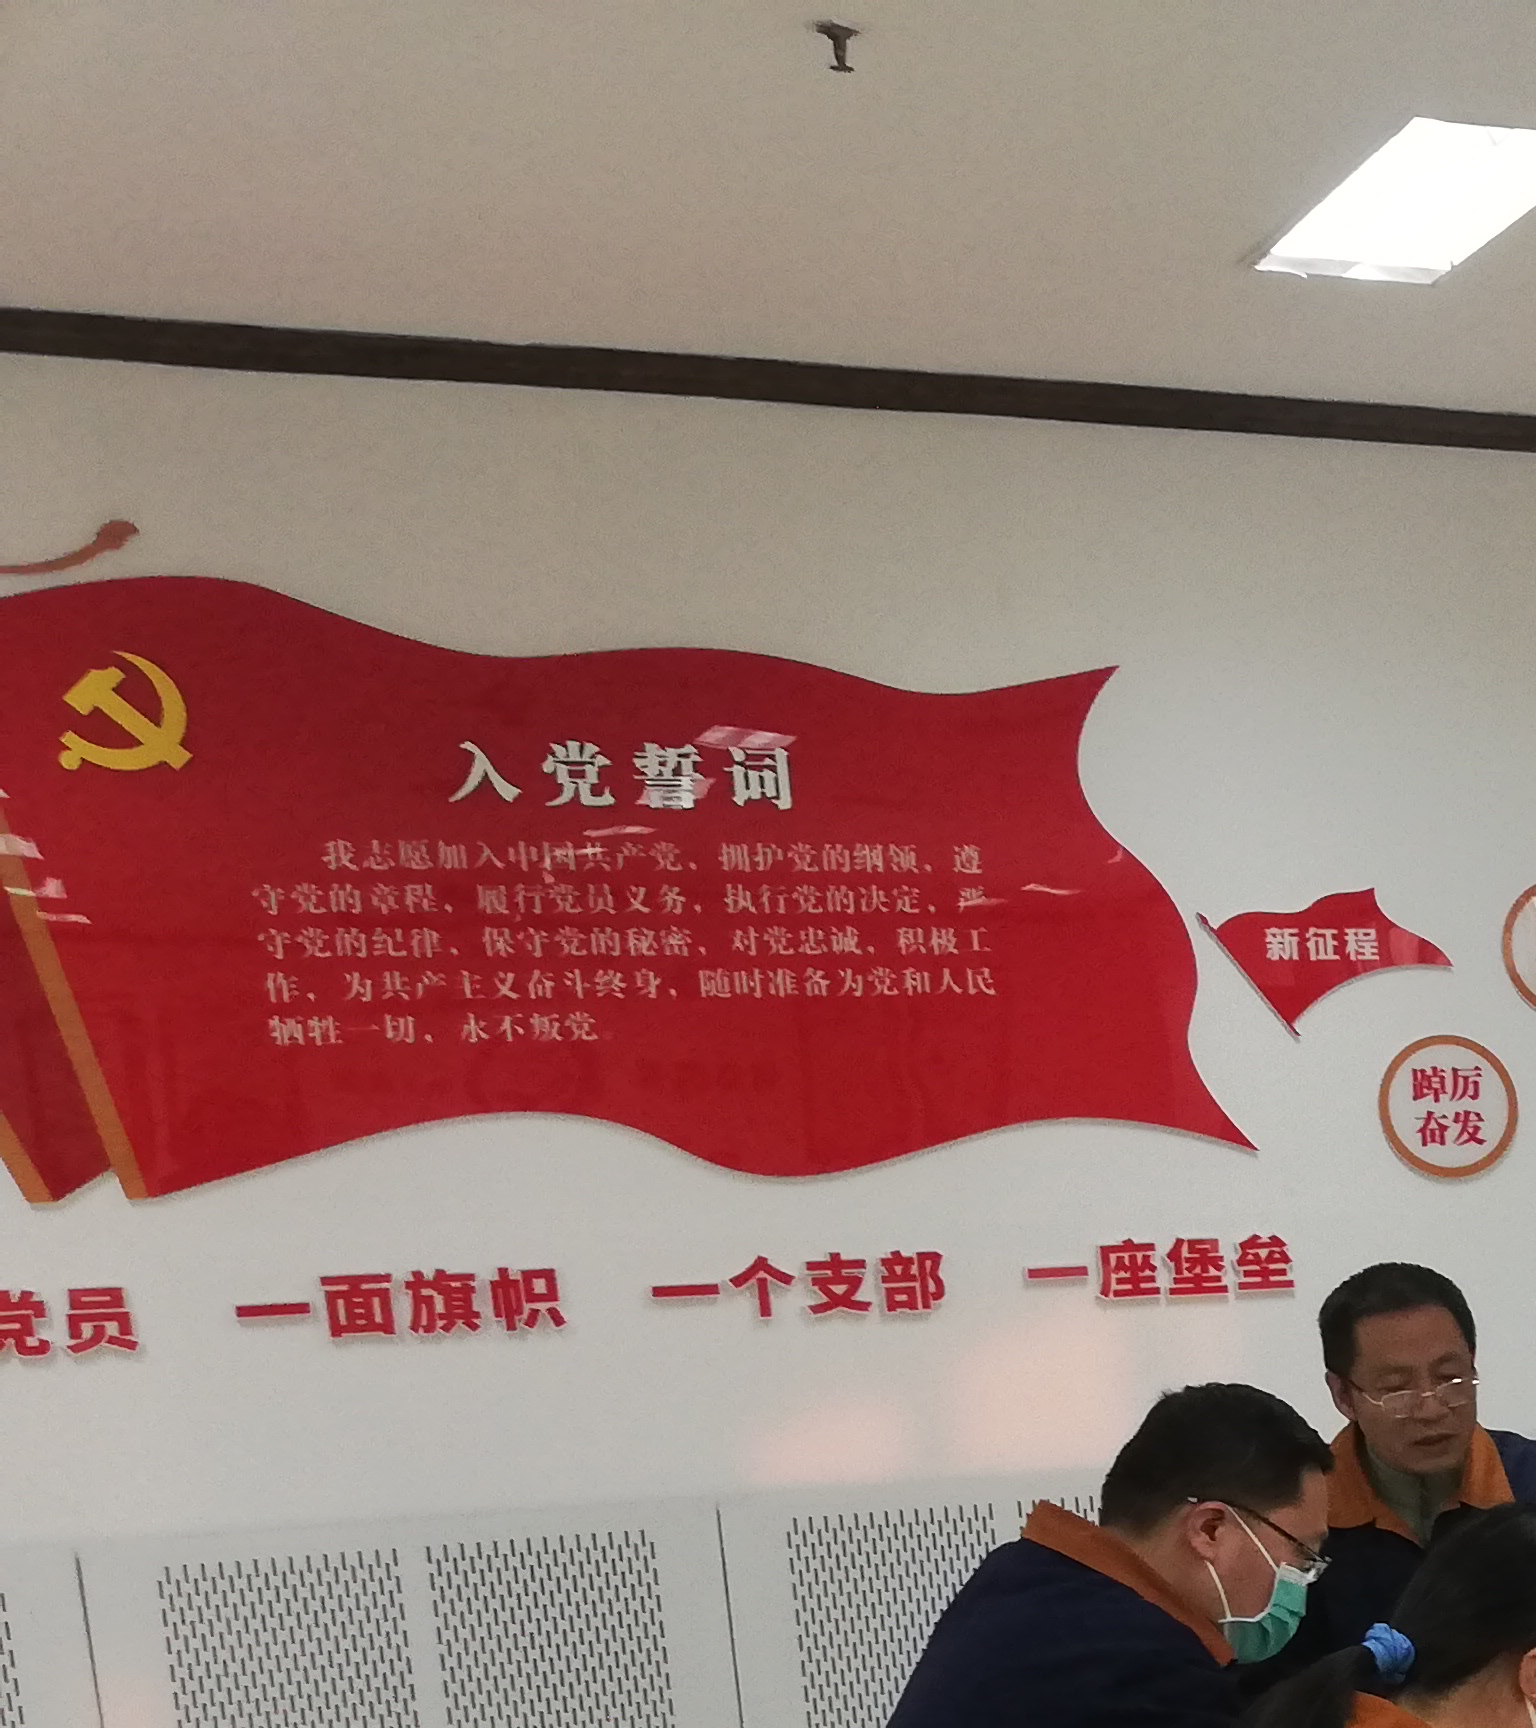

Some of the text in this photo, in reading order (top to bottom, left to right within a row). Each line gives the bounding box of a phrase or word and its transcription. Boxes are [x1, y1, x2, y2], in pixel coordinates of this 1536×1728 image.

[448, 740, 793, 810] 入党誓词
[1264, 926, 1380, 962] 新征程
[1411, 1065, 1483, 1103] 踔厉
[1415, 1109, 1488, 1147] 奋发
[0, 1233, 1297, 1358] 党员 一面旗帜 一个支部 一座堡垒
